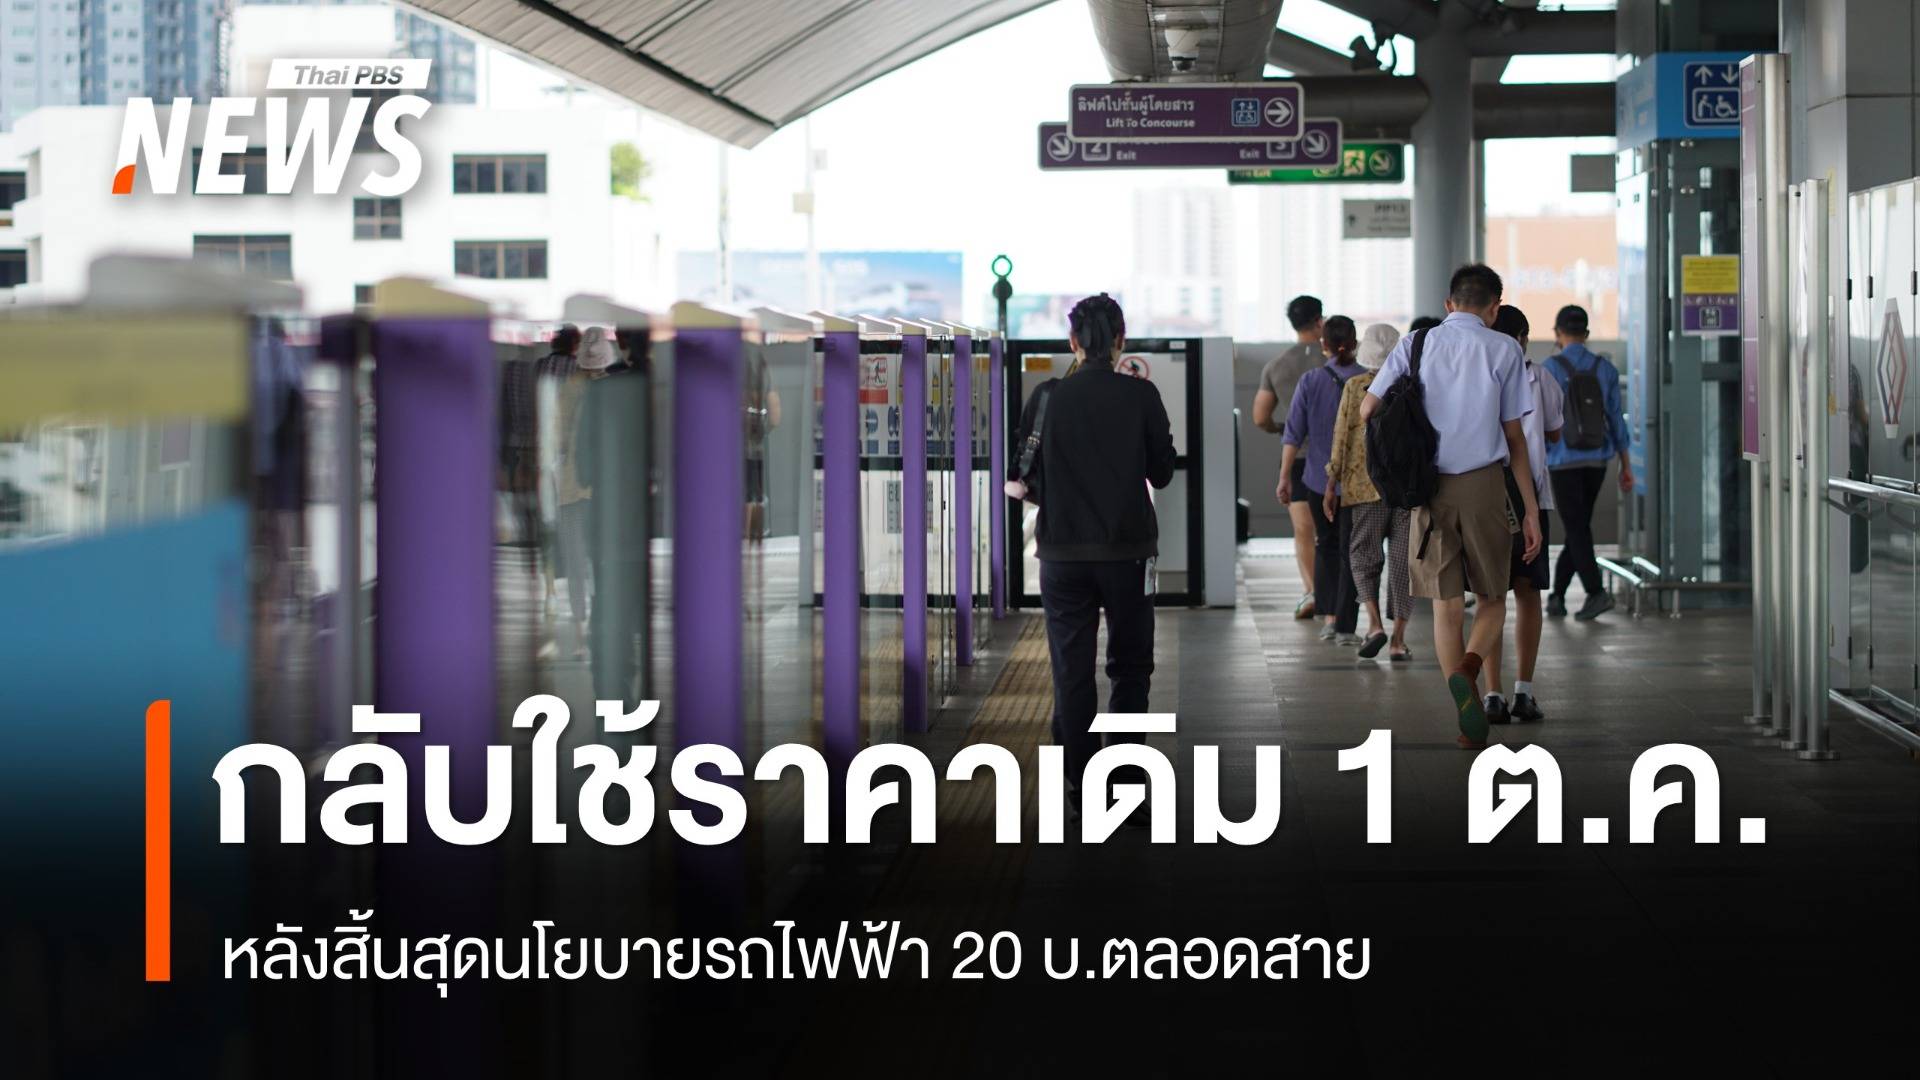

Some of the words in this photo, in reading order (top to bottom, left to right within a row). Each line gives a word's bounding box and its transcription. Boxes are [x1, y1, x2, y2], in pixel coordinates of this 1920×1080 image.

[1105, 118, 1124, 128] Lift
[1140, 118, 1196, 128] Concourse
[1116, 150, 1137, 160] Exit
[1239, 150, 1260, 159] Exit
